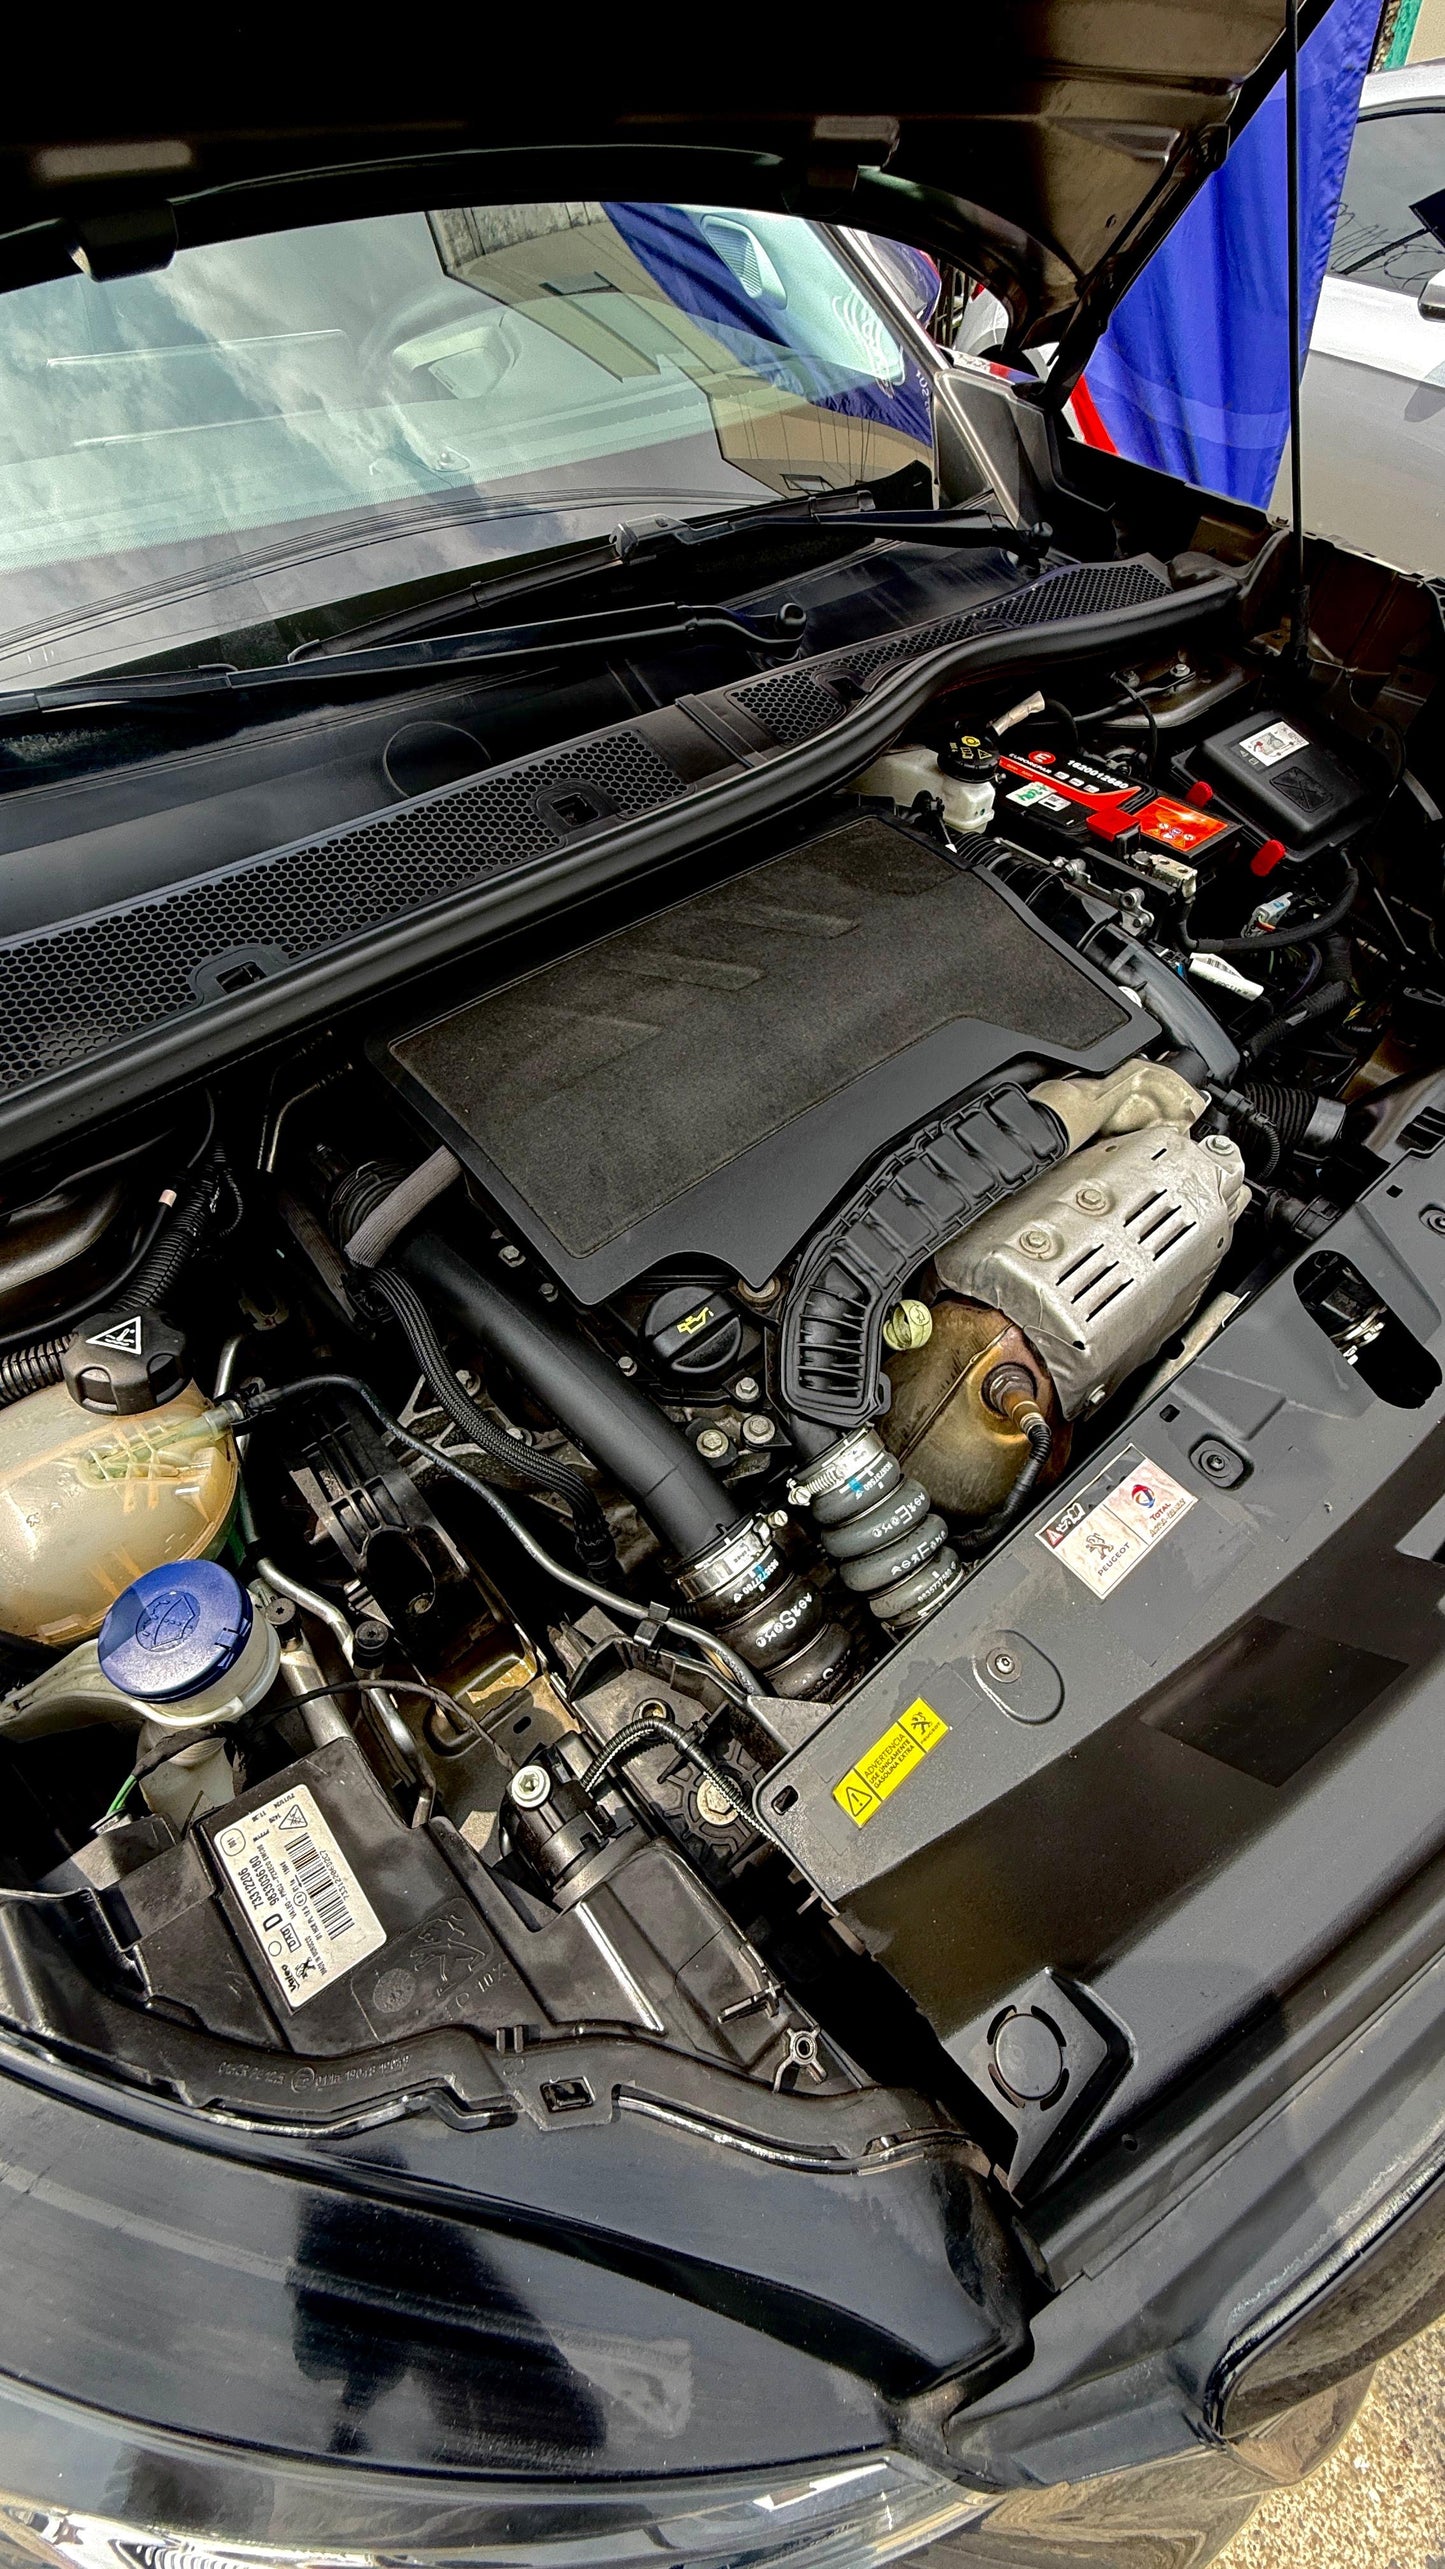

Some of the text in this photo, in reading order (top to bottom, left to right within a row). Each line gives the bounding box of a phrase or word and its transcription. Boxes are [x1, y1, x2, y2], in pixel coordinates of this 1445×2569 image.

[1008, 753, 1052, 774] EUROREPAR
[1067, 759, 1129, 789] 1620012680
[1149, 1503, 1171, 1521] TOTAL
[1097, 1542, 1130, 1576] PEUGEOT
[865, 1733, 905, 1778] ADVERTENCIA
[874, 1744, 915, 1788] GASOLINA EXTRA
[868, 1771, 880, 1784] USE
[238, 1867, 264, 1910] 73312206
[249, 1855, 280, 1906] 9833036180
